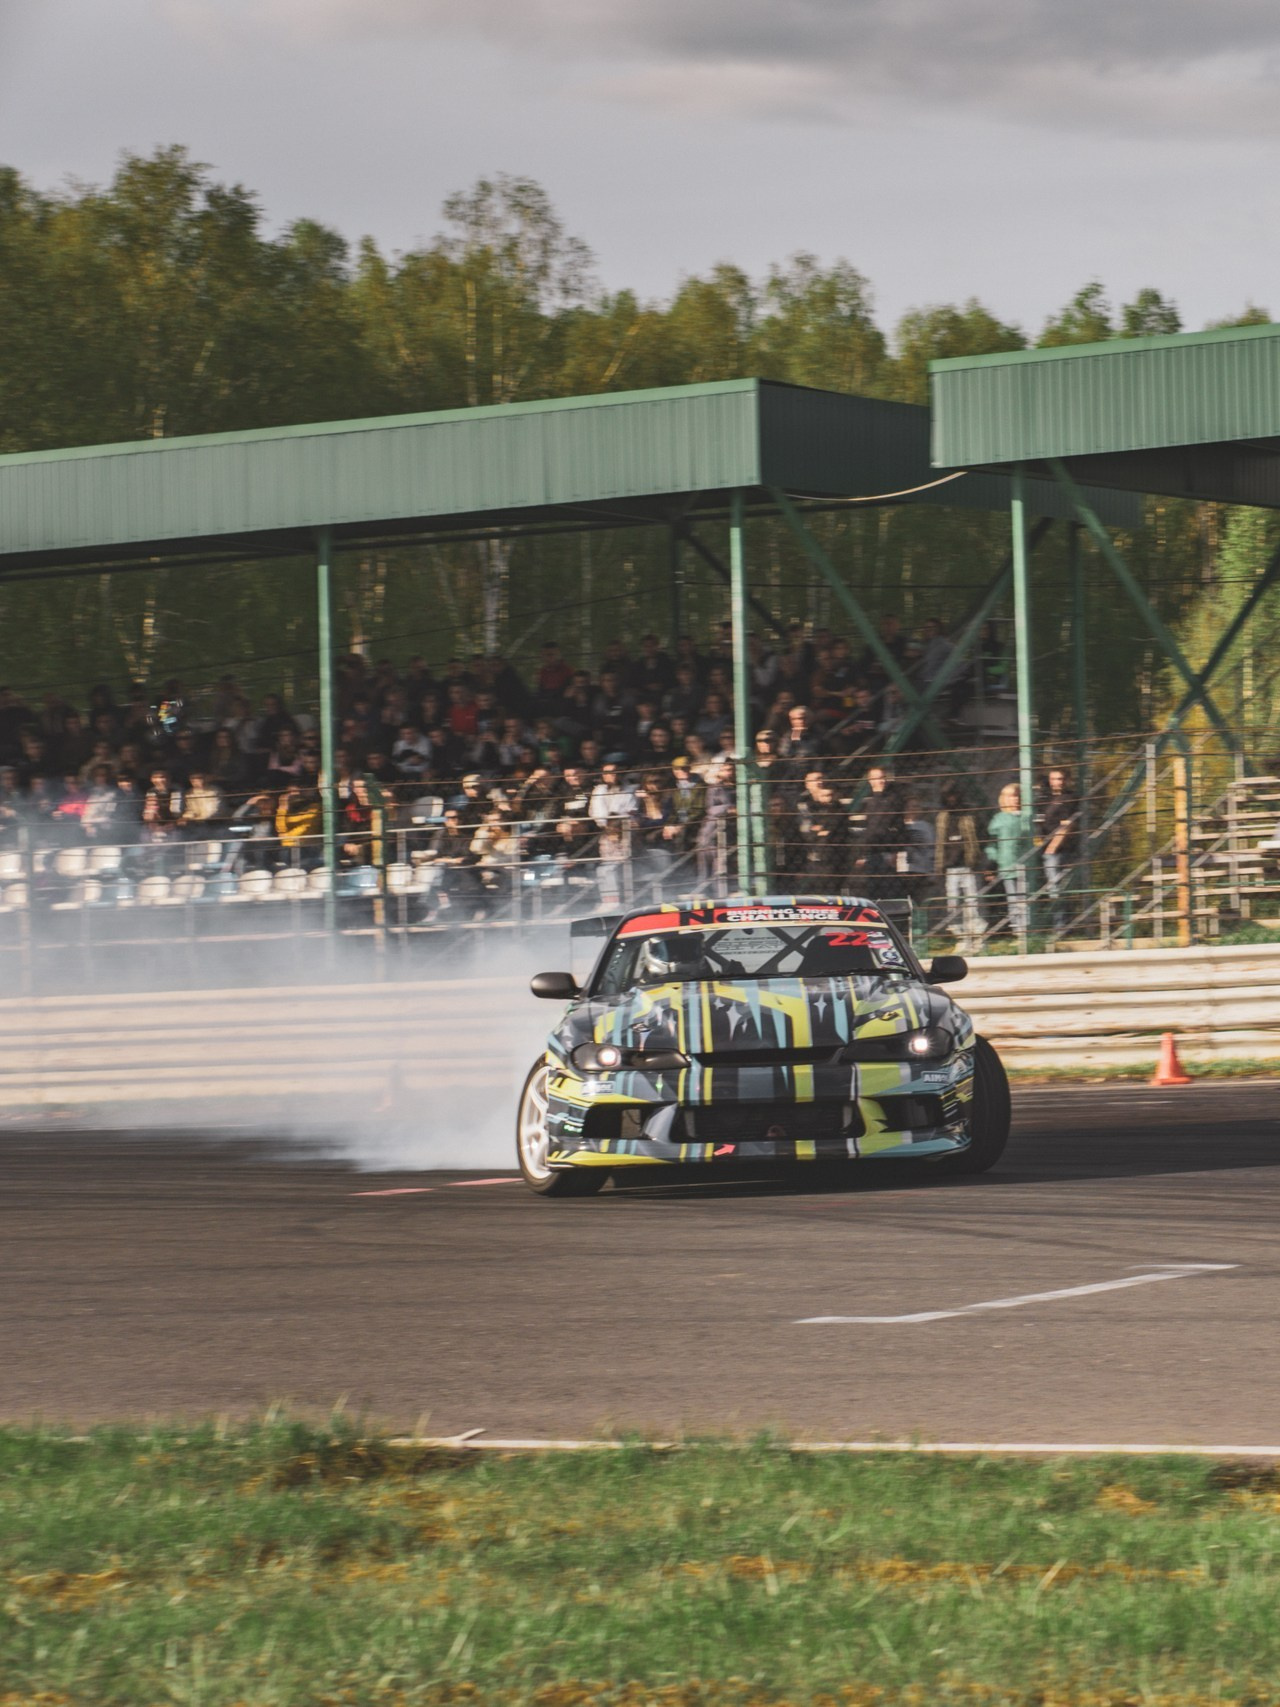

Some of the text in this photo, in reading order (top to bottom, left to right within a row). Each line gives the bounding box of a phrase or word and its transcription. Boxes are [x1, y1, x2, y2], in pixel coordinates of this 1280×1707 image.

[727, 908, 794, 916] BURNING
[727, 913, 840, 922] CHALLENGE
[825, 931, 870, 947] 22
